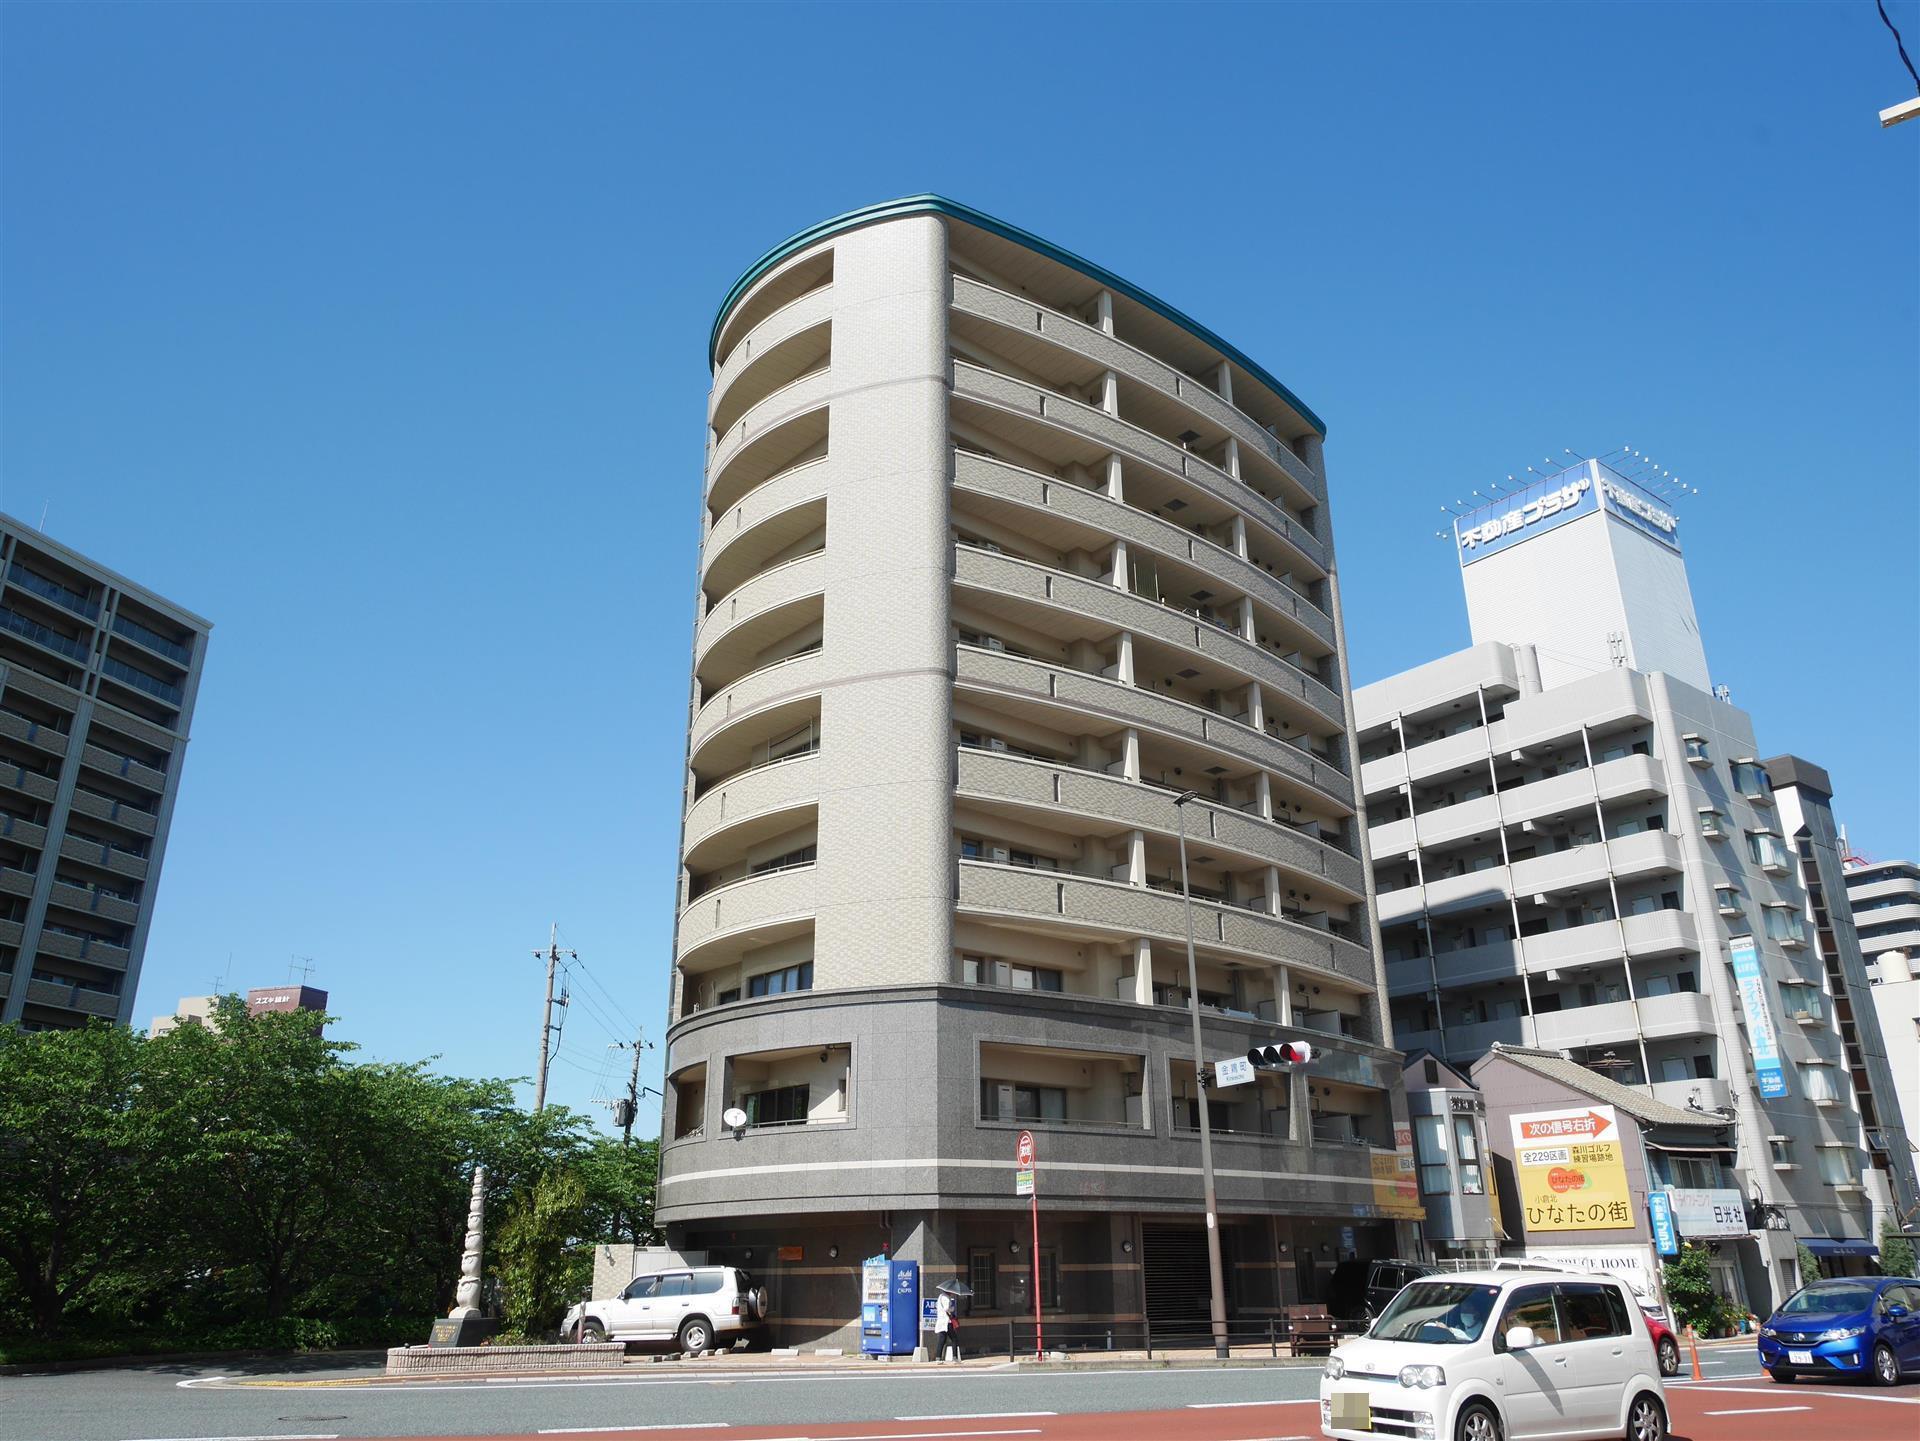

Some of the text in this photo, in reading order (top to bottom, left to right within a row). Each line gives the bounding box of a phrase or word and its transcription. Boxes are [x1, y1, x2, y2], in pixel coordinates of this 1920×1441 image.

[1461, 478, 1591, 549] 不動産プラザ
[1529, 1118, 1596, 1135] 次の信号右折
[1572, 1144, 1611, 1154] 森川ゴルフ
[1524, 1150, 1567, 1162] 全229区画
[1573, 1153, 1614, 1163] 練習場跡地
[1535, 1194, 1557, 1204] 小倉北
[1526, 1201, 1628, 1224] ひなたの街
[1713, 1205, 1743, 1223] 日光社
[1601, 1258, 1640, 1269] HOME
